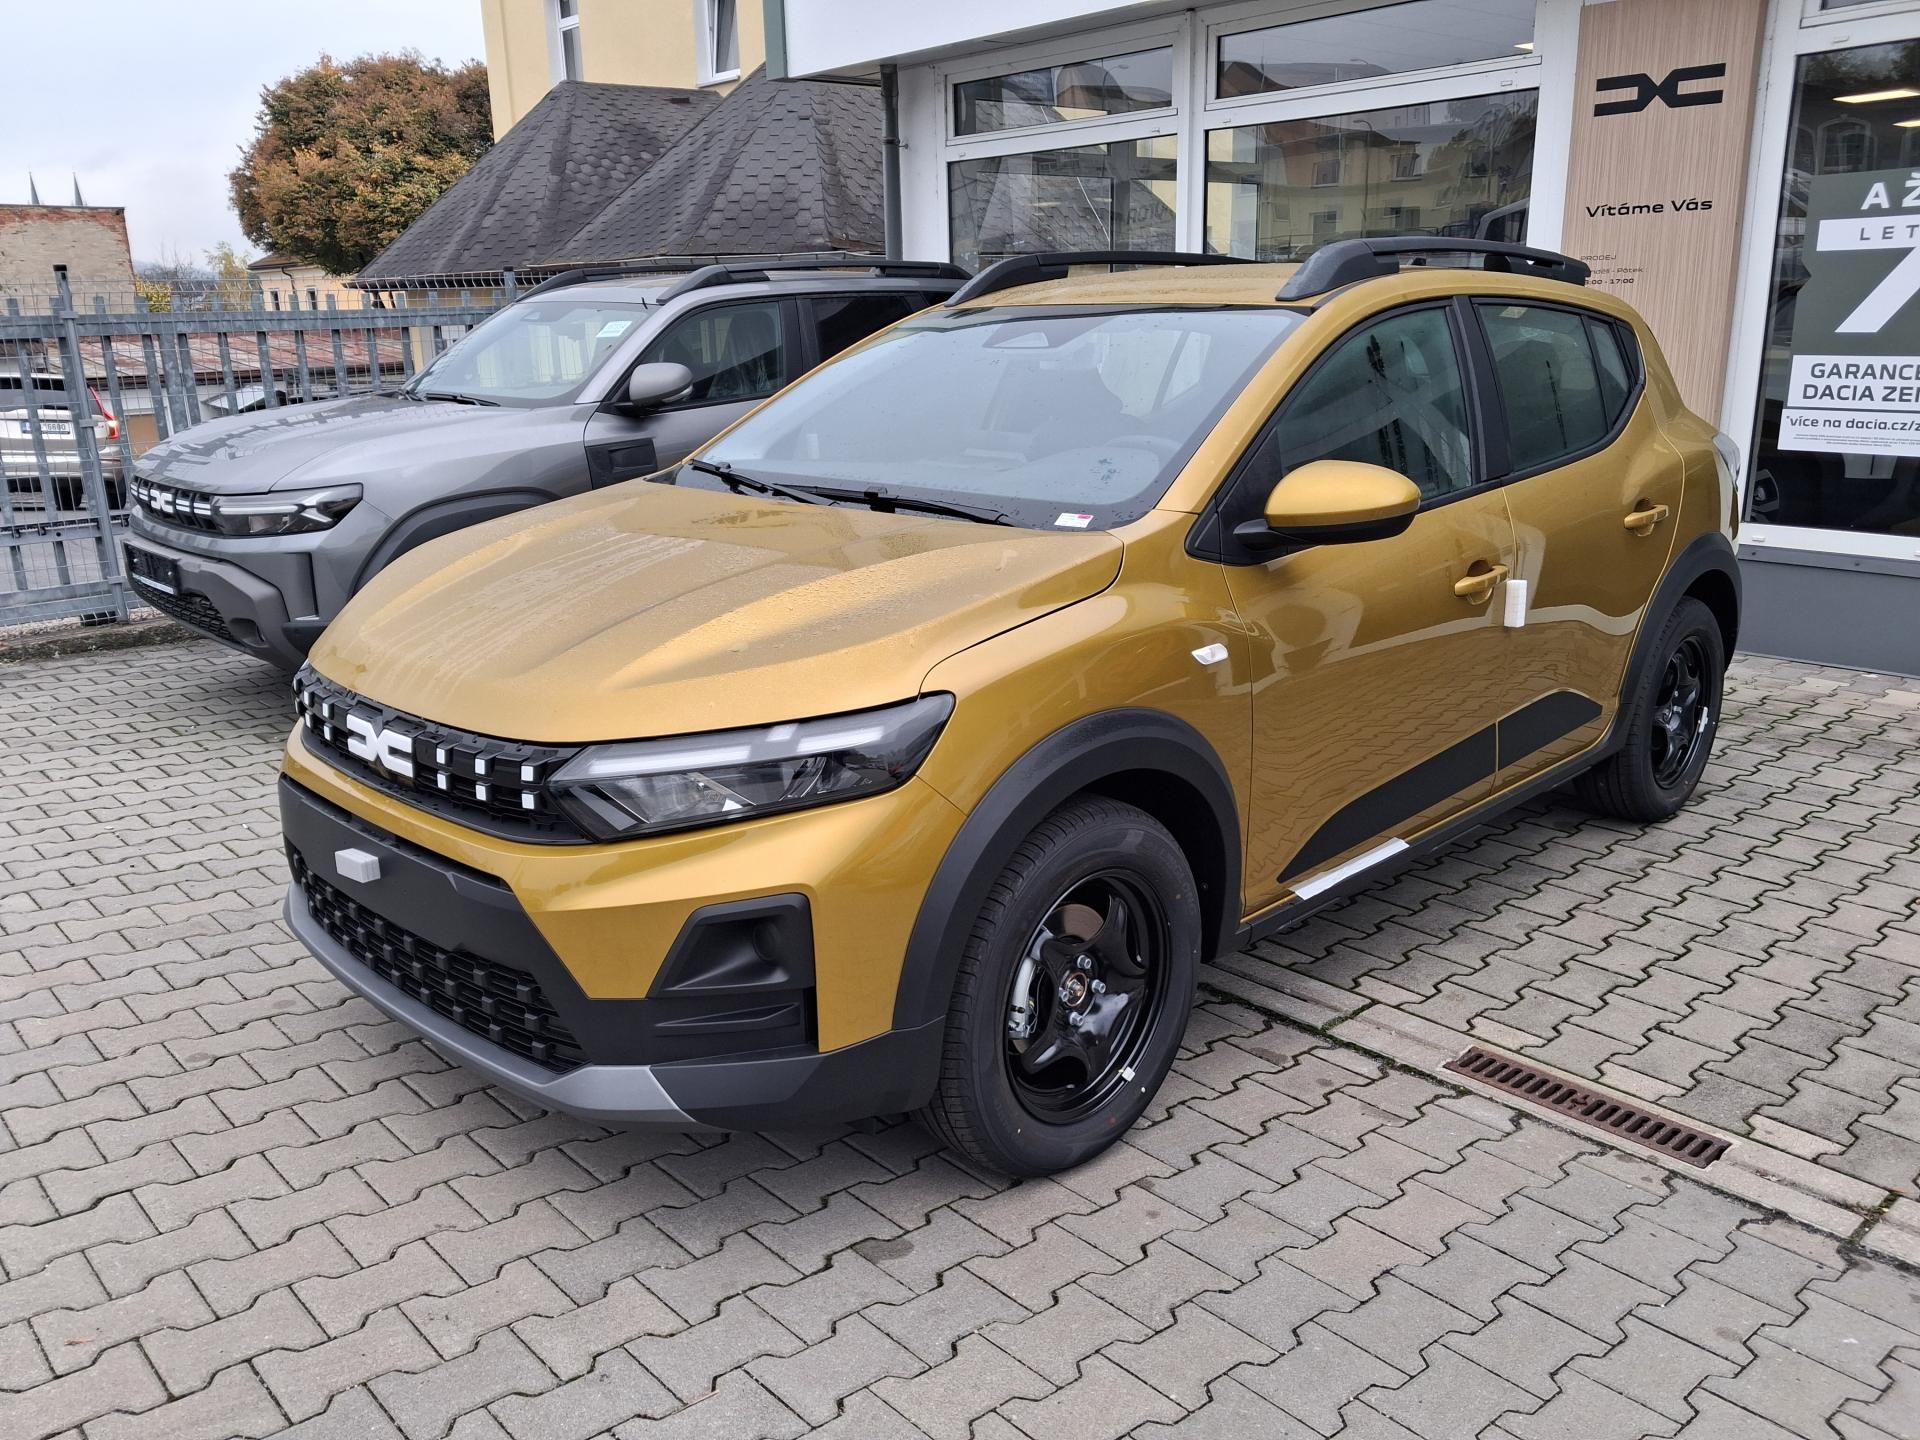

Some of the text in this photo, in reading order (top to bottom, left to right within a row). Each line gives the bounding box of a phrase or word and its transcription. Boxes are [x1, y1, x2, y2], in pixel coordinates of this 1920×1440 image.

[1586, 197, 1713, 218] Vítáme Vás
[1859, 224, 1920, 241] LET
[1802, 383, 1875, 402] DACIA
[1822, 419, 1842, 428] na
